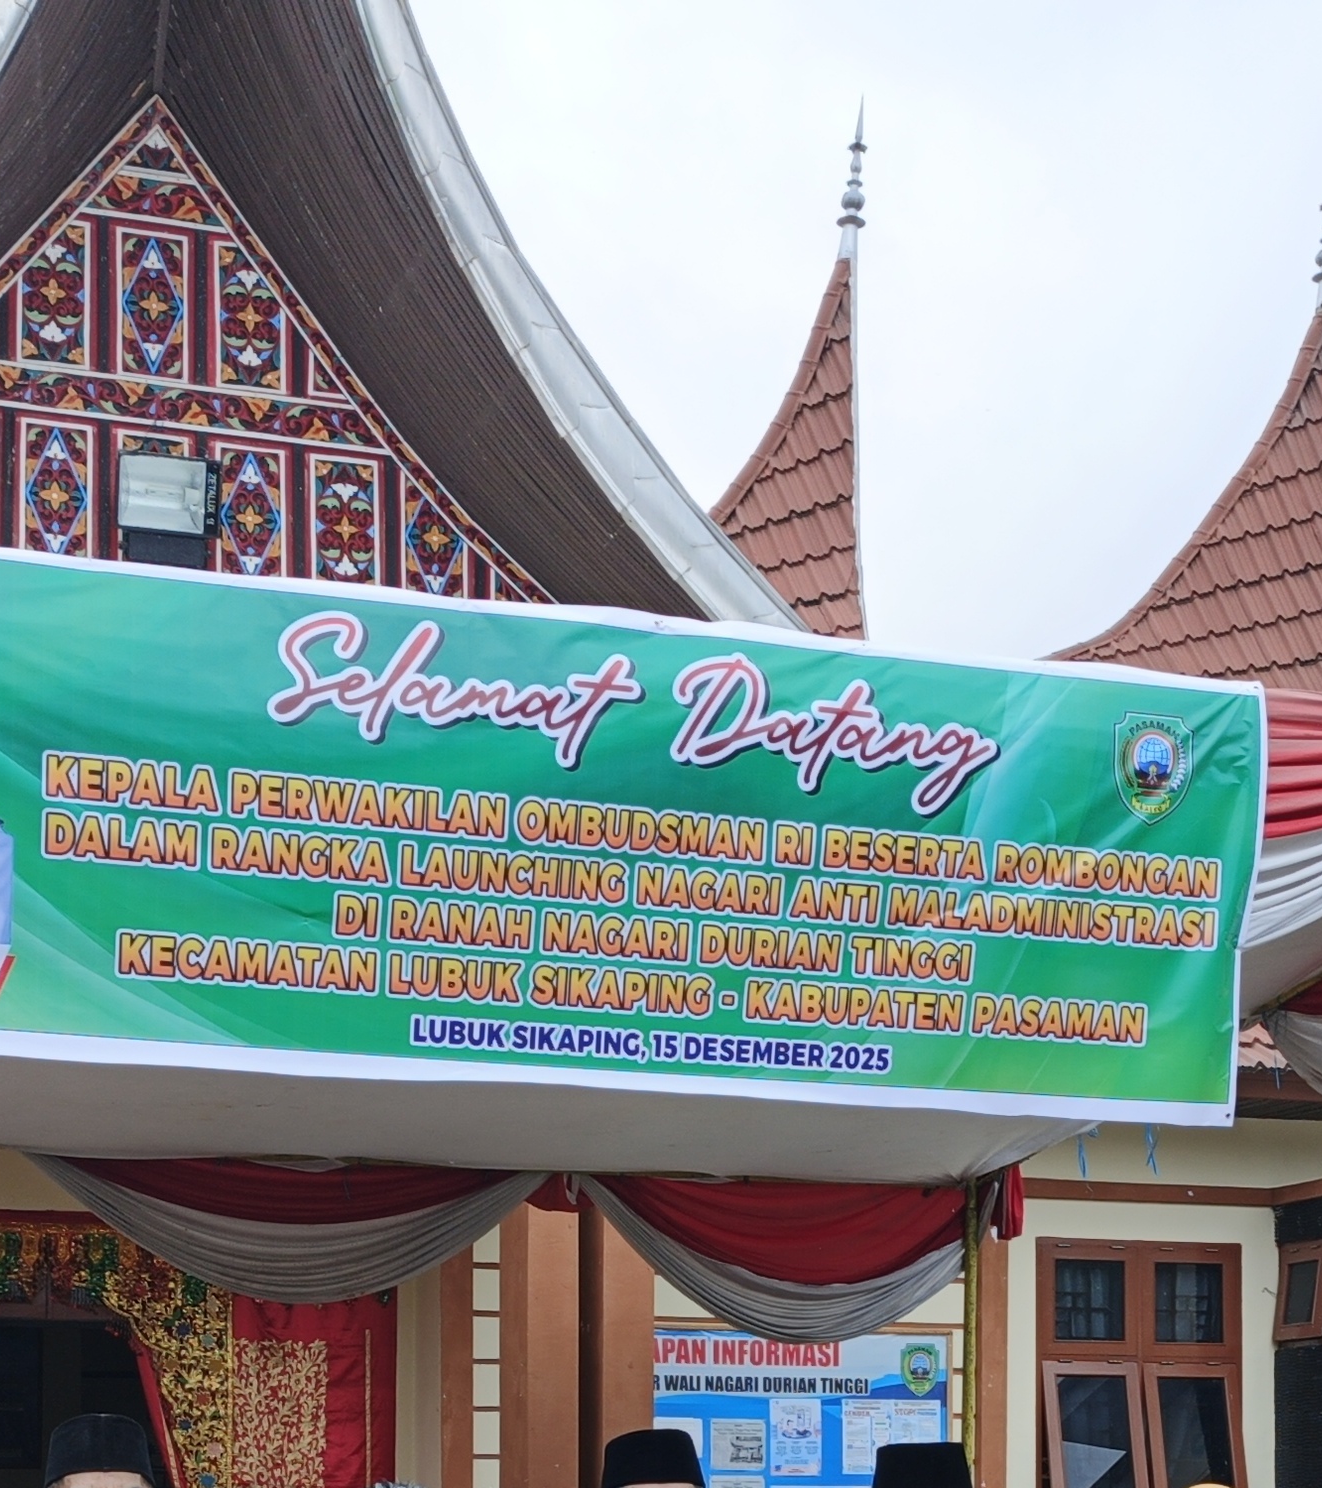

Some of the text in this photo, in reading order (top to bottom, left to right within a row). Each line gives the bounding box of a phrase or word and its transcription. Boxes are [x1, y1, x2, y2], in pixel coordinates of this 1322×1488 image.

[272, 616, 997, 812] Selamat Datang
[46, 754, 1218, 898] KEPALA PERWAKILAN OMBUDSMAN RI BESERTA ROMBONGAN
[46, 812, 1216, 947] DALAM RANGKA LAUNCHING NAGARI ANTI MALADMINISTRASI
[118, 932, 1145, 1043] KECAMATAN LUBUK SIKAPING - KABUPATEN PASAMAN
[335, 893, 972, 982] DI RANAH NAGARI DURIAN TINGGI
[413, 1018, 890, 1071] LUBUK SIKAPING, 15 DESEMBER 2025
[664, 1375, 701, 1392] WALI
[705, 1376, 759, 1393] NAGARI
[763, 1377, 817, 1394] DURIAN
[820, 1377, 869, 1395] TINGGI
[713, 1339, 841, 1367] INFORMASI
